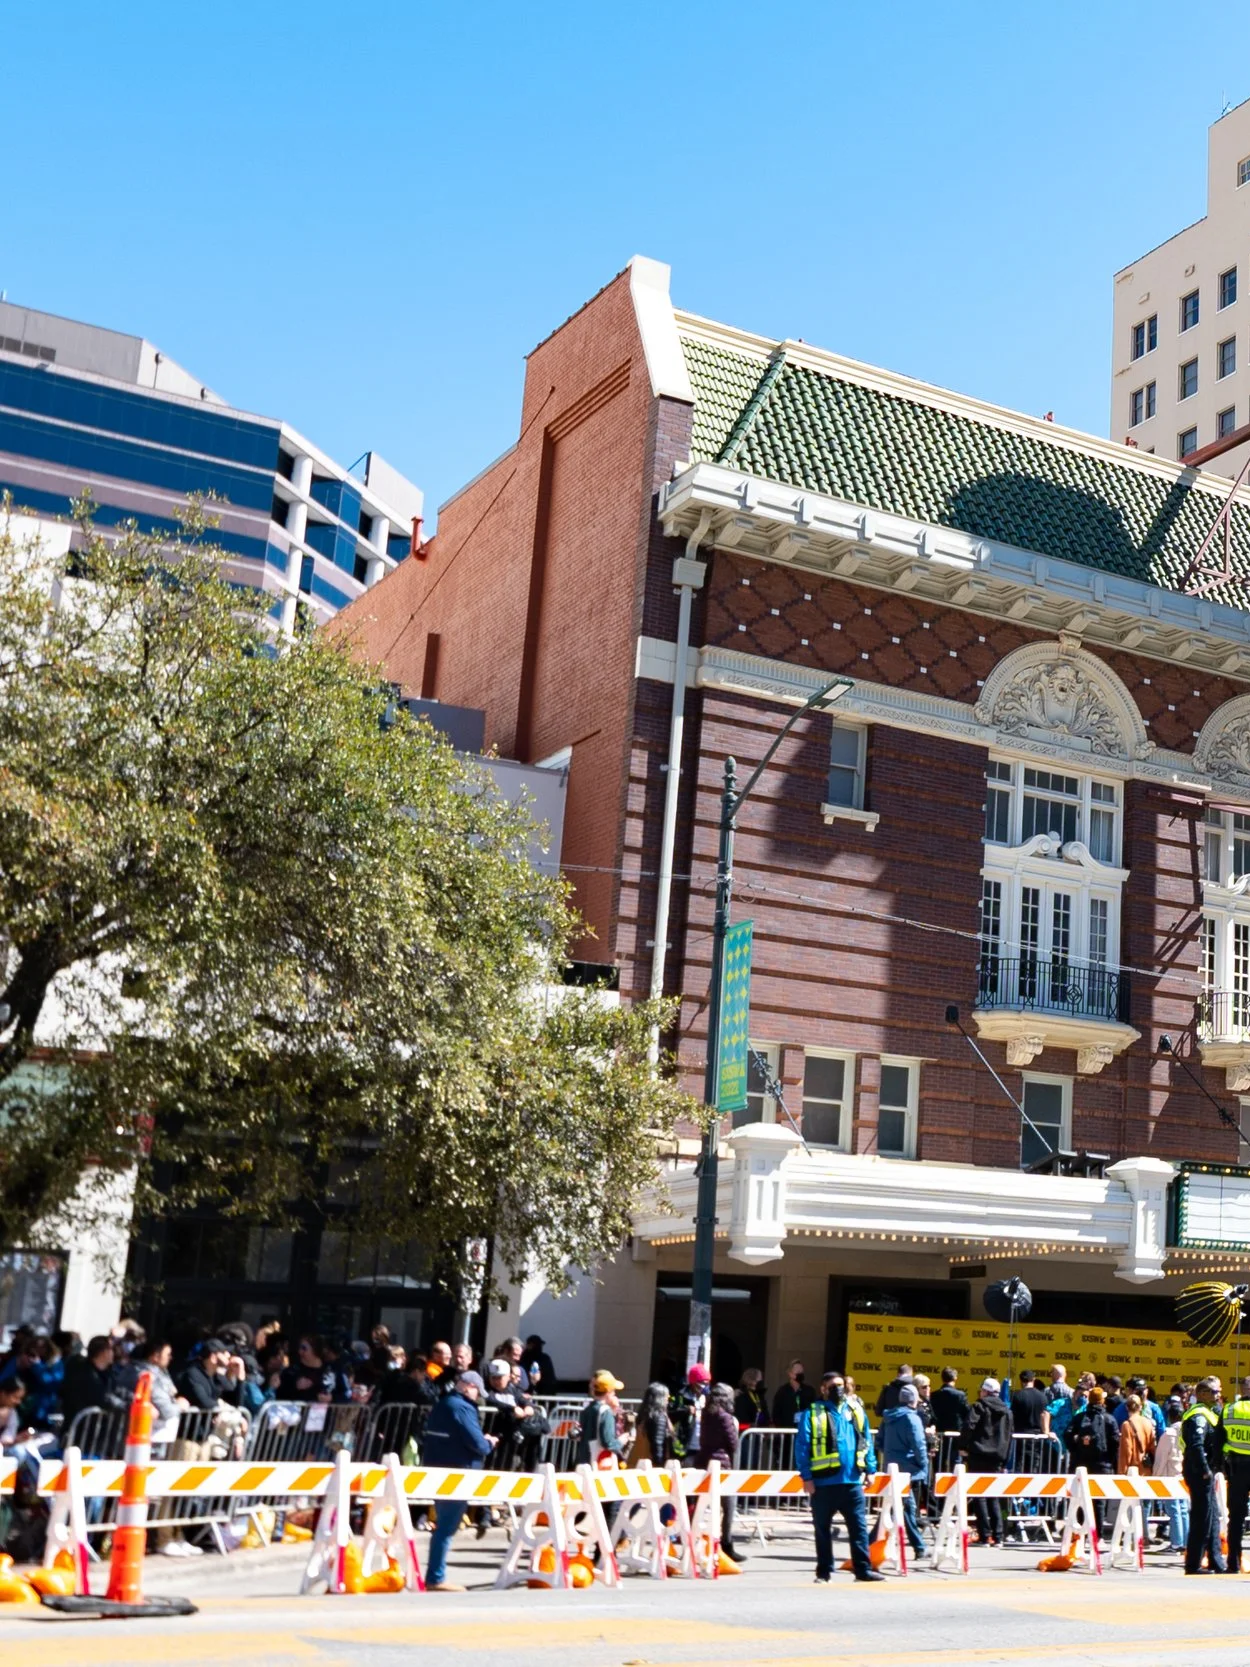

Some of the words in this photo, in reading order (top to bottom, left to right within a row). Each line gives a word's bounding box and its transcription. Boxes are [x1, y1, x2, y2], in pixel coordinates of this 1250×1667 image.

[855, 1323, 877, 1332] SXSW
[914, 1327, 936, 1335] SXSW
[971, 1330, 993, 1338] SXSW
[1028, 1333, 1049, 1341] SXSW
[1081, 1335, 1100, 1343] SXSW
[1132, 1338, 1151, 1346] SXSW
[884, 1344, 906, 1353] SXSW
[942, 1348, 964, 1356] SXSW
[1055, 1352, 1074, 1360] SXSW
[1106, 1354, 1125, 1363] SXSW
[1157, 1357, 1175, 1365] SXSW
[1206, 1359, 1224, 1367] SXSW
[853, 1362, 875, 1371] SXSW
[971, 1367, 992, 1375] SXSW
